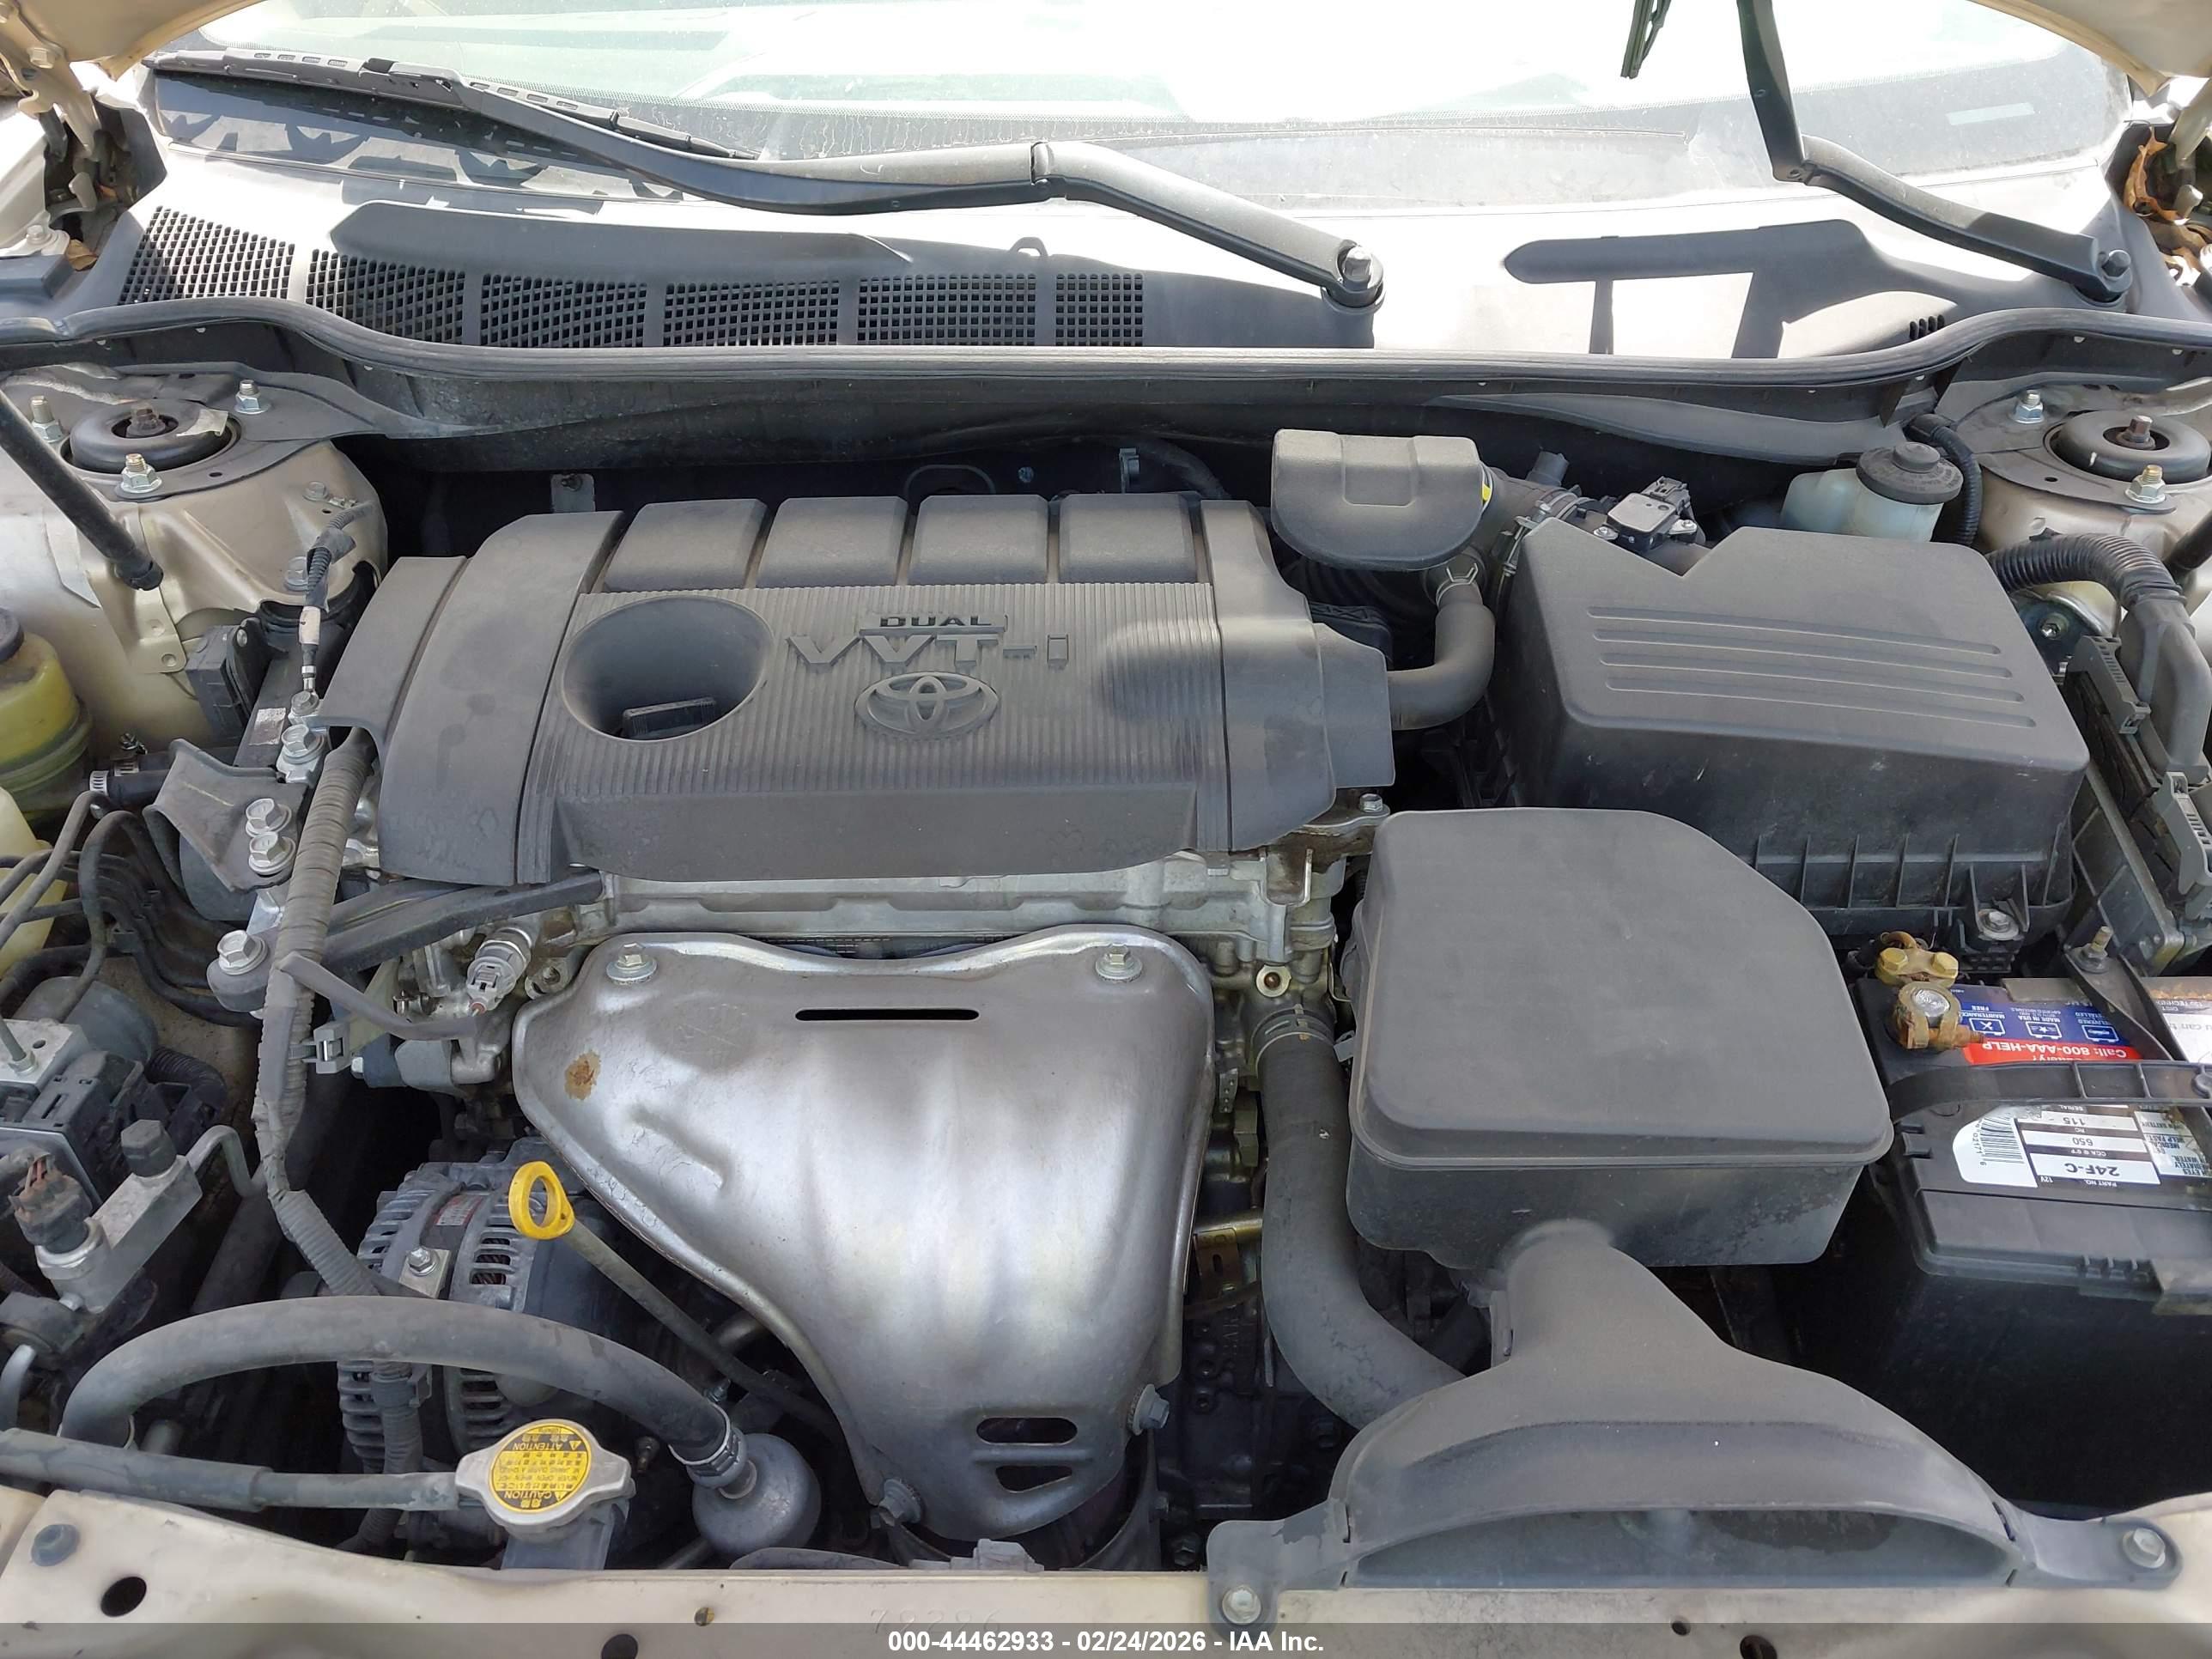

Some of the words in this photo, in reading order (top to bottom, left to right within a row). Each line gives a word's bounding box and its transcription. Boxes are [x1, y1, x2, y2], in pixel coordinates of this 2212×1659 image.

[879, 616, 992, 628] DUAL
[1981, 1041, 2090, 1055] 800-AAA-HELP
[2094, 1047, 2127, 1058] Call:
[2063, 1117, 2086, 1126] 115
[2072, 1137, 2094, 1146] 650
[2064, 1163, 2120, 1177] 24F-C
[504, 1491, 552, 1499] CAUTION
